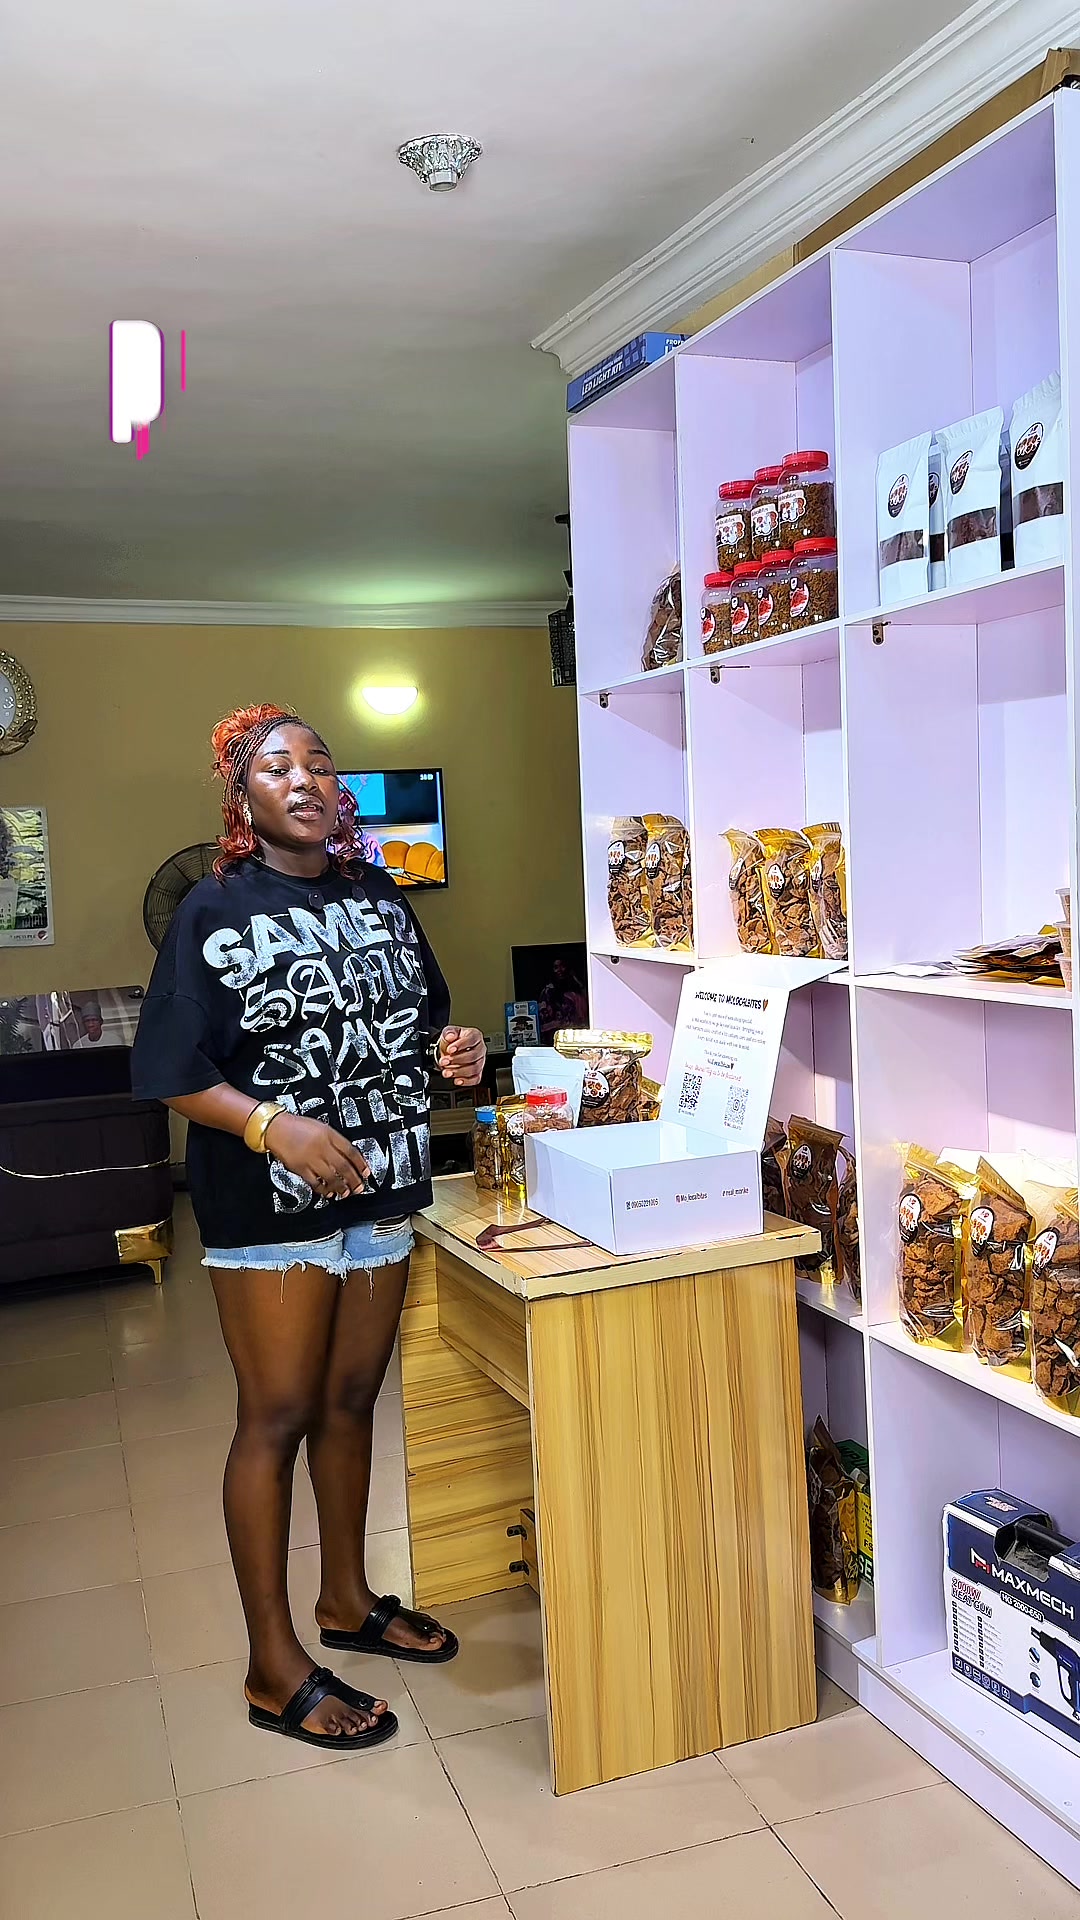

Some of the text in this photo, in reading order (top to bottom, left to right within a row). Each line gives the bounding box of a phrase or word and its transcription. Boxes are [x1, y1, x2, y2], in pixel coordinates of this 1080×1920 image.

[582, 380, 593, 396] LED
[593, 368, 611, 388] LIGHT
[611, 360, 623, 376] KIT
[203, 897, 394, 989] SAME
[694, 990, 718, 1003] WELCOME
[718, 993, 726, 1004] TO
[252, 1007, 421, 1086] SAME
[951, 1576, 981, 1601] 2000W
[951, 1587, 993, 1618] HEAT GUN
[991, 1562, 1075, 1621] MAXMECH
[1001, 1593, 1013, 1604] HG
